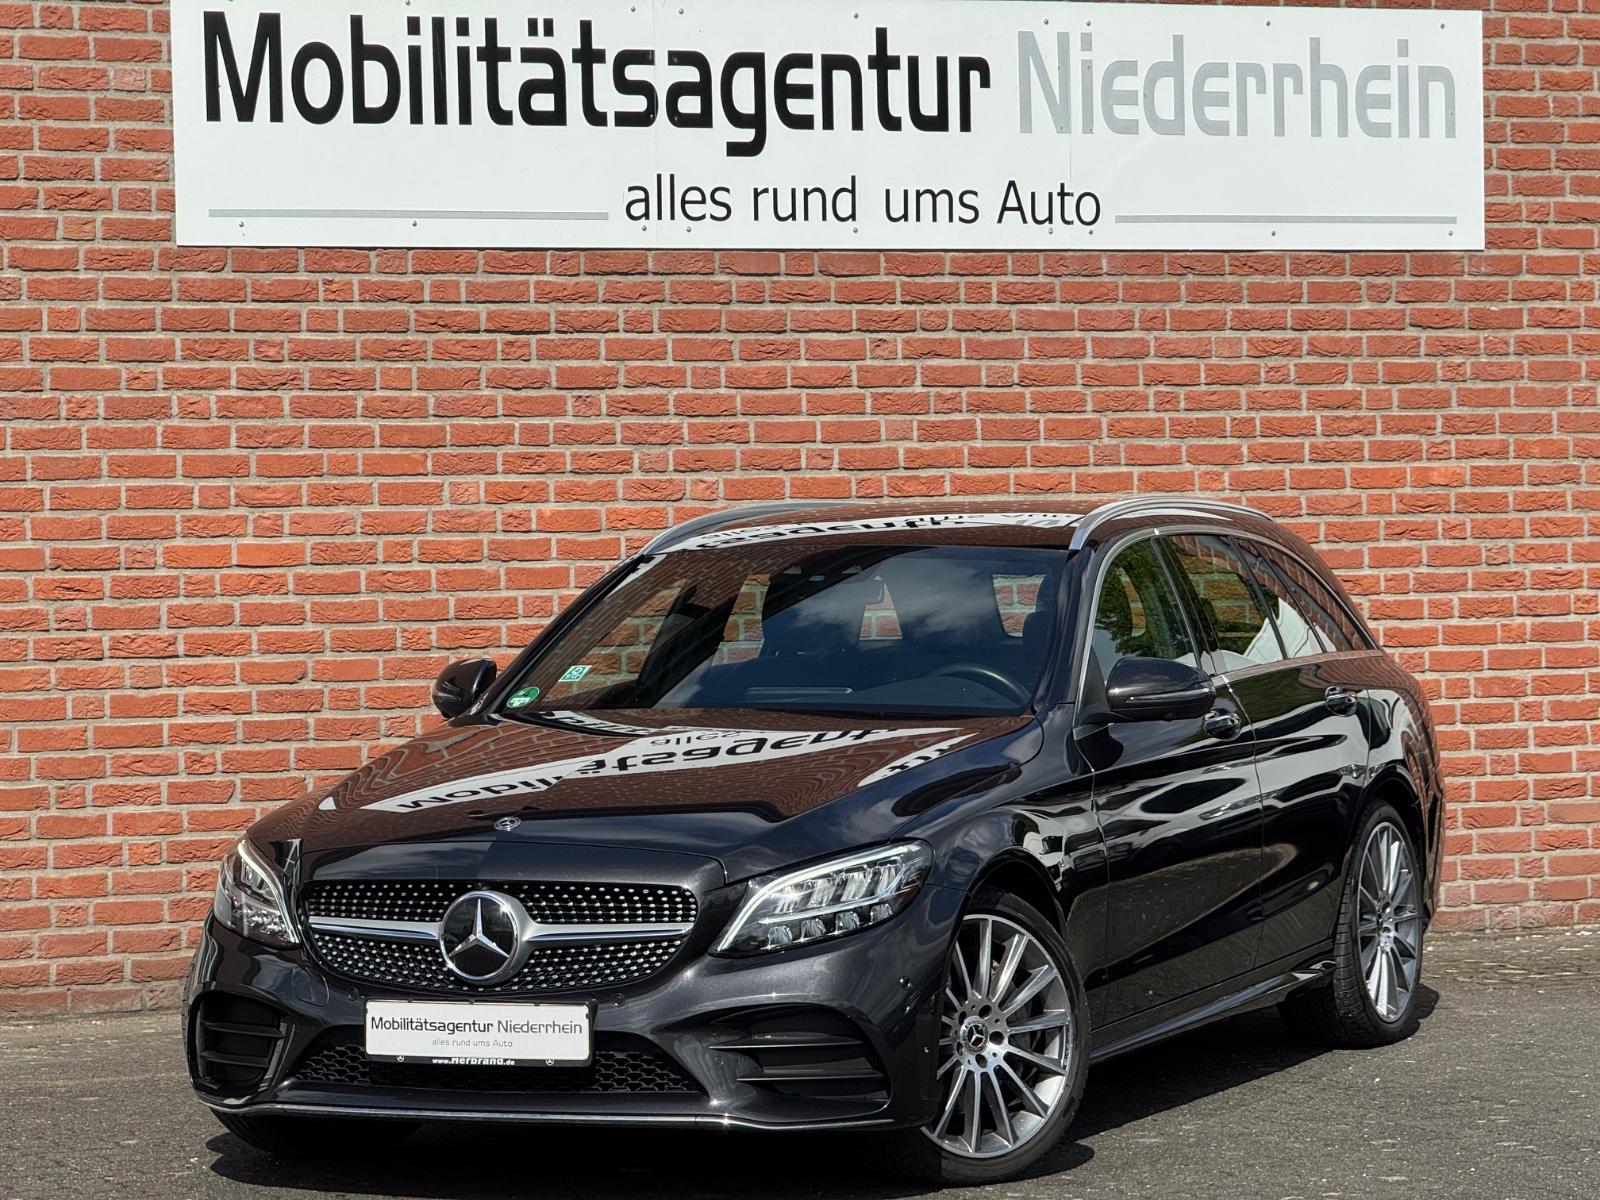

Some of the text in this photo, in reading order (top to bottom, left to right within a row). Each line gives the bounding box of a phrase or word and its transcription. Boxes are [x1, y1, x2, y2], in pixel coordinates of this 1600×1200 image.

[205, 12, 1456, 157] Mobilitätsagentur Niederrhein
[626, 174, 1101, 226] alles rund ums Auto
[371, 1016, 583, 1035] Mobilitätsagentur Niederrhein
[432, 1038, 450, 1046] alles
[452, 1038, 471, 1047] rund
[492, 1039, 513, 1047] Auto
